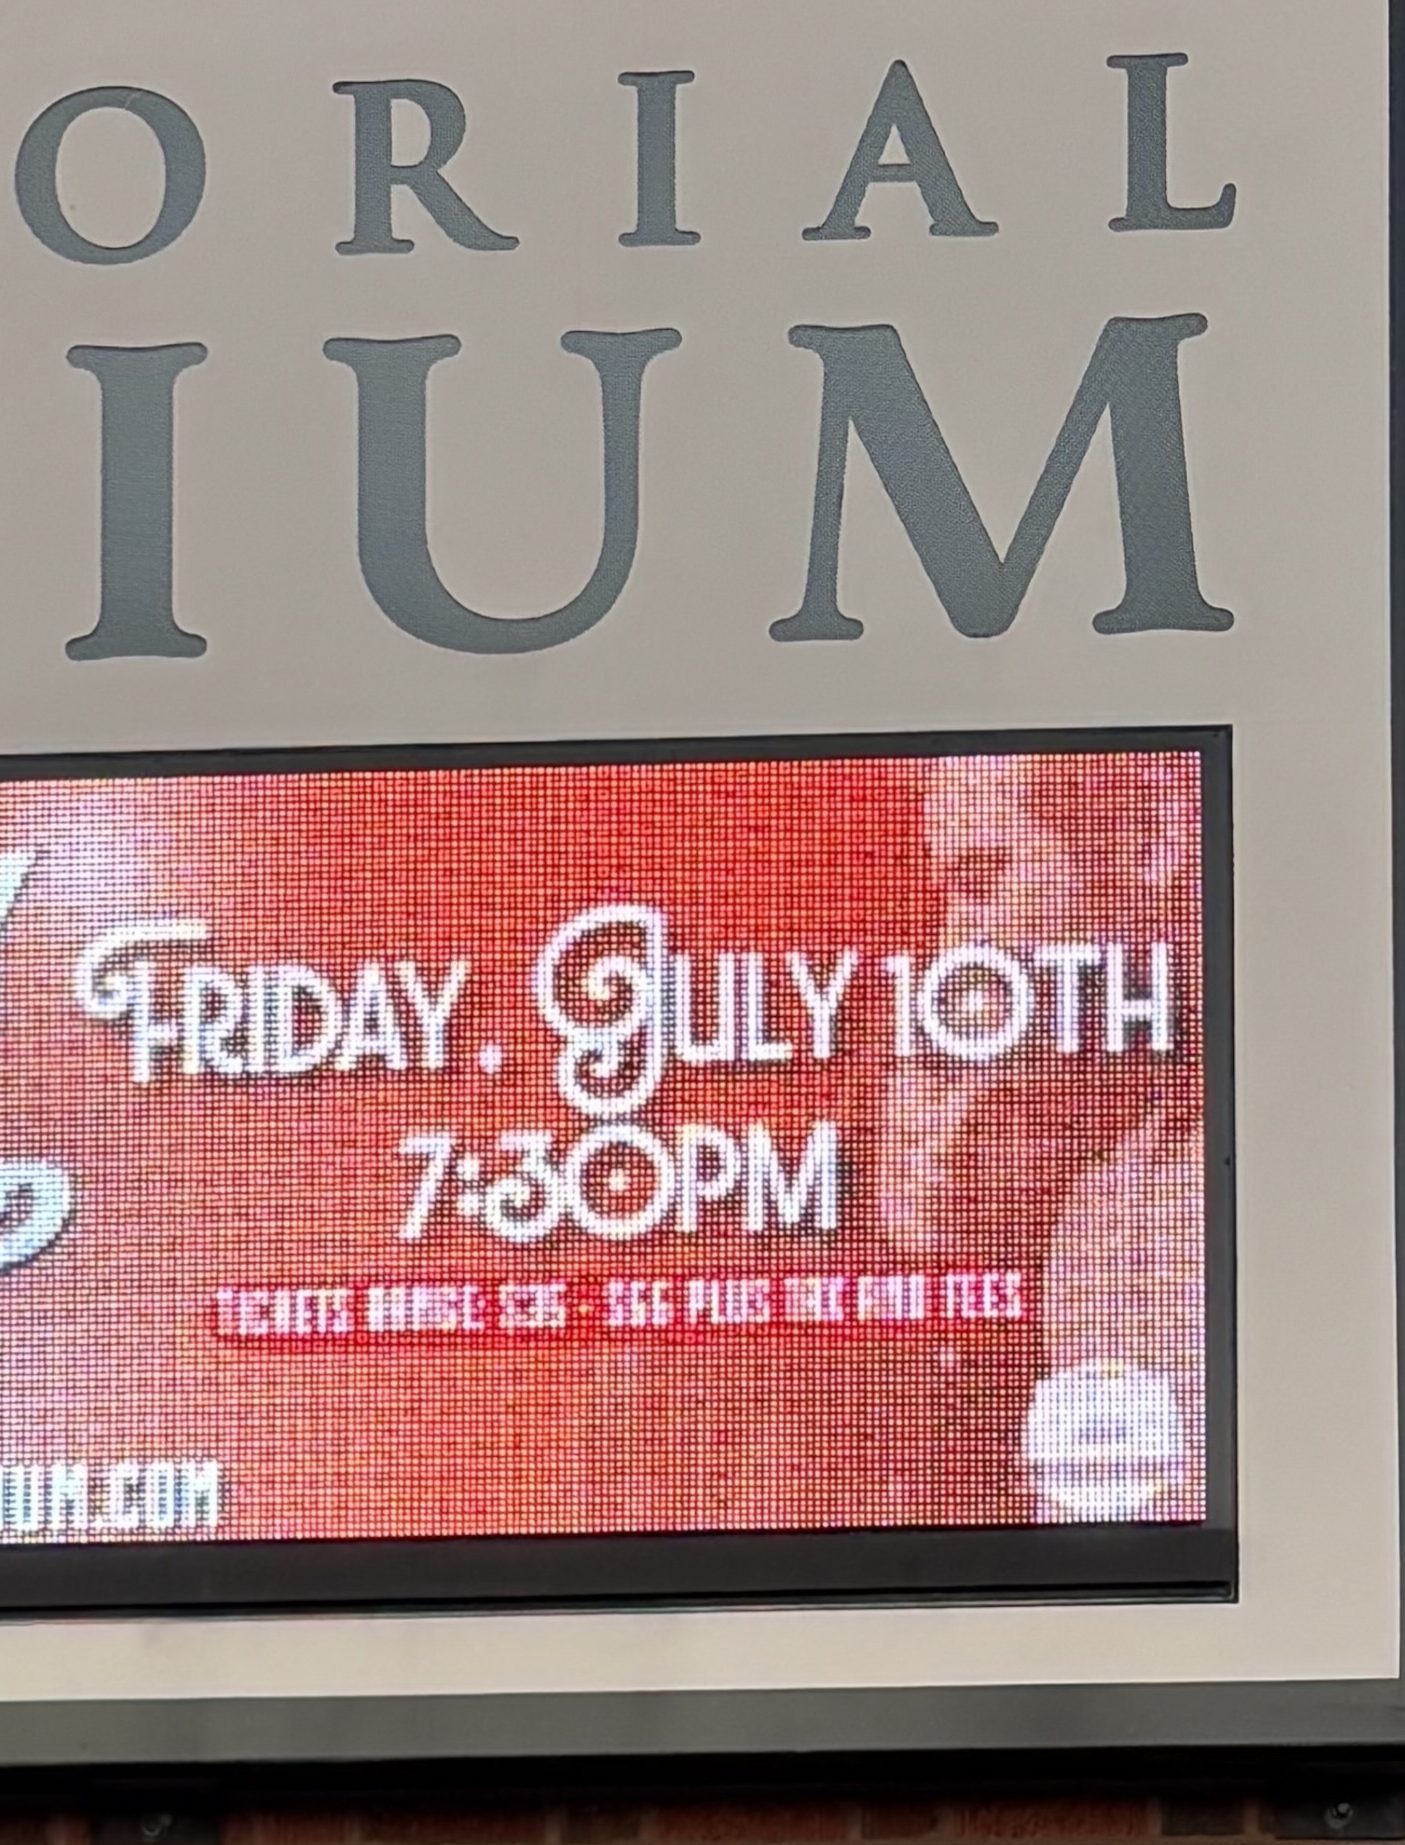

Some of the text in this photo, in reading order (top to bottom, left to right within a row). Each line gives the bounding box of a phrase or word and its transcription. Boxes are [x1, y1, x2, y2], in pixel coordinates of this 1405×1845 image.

[886, 938, 1176, 1062] 10TH
[394, 1117, 841, 1244] 7:30PM
[217, 1285, 352, 1337] TICKETS
[689, 1276, 771, 1324] PLUS
[944, 1269, 1022, 1319] FEES
